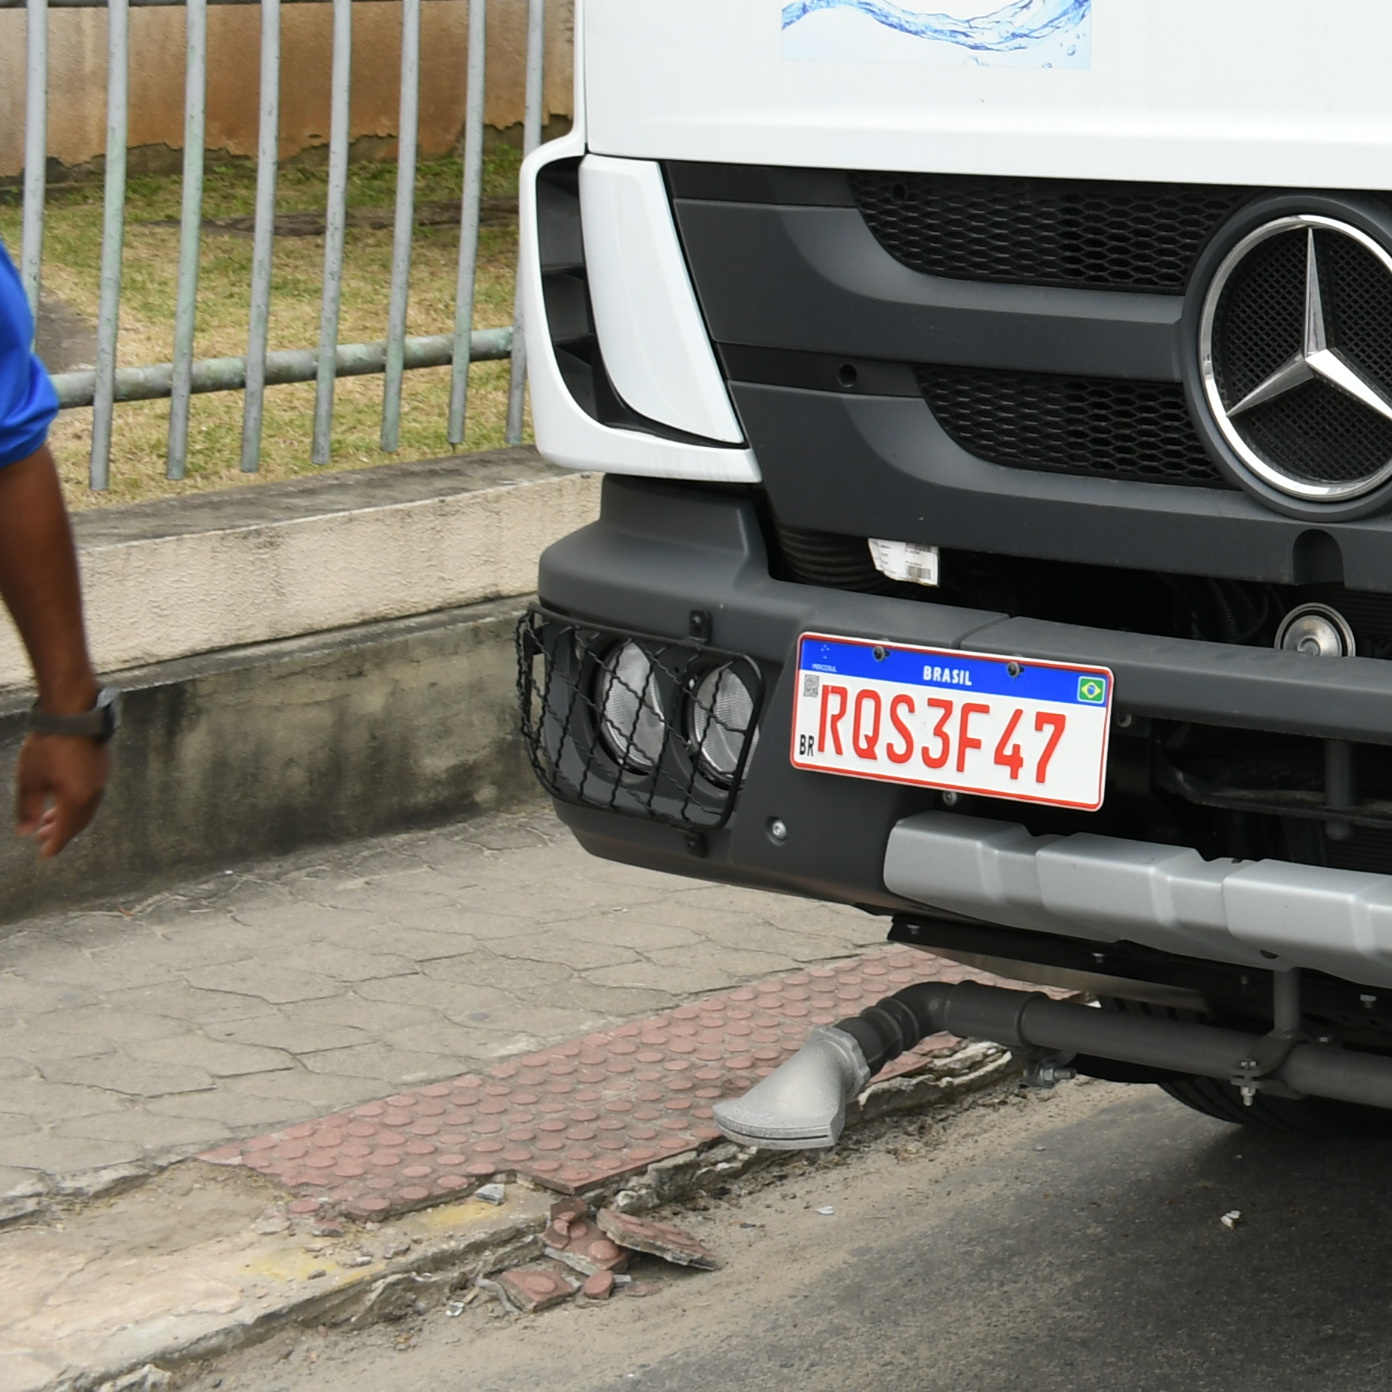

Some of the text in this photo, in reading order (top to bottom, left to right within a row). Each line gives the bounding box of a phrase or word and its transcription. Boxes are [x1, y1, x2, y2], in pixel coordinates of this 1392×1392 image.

[923, 664, 972, 686] BRASIL
[799, 734, 814, 758] BR
[817, 684, 1067, 784] RQS3F47
